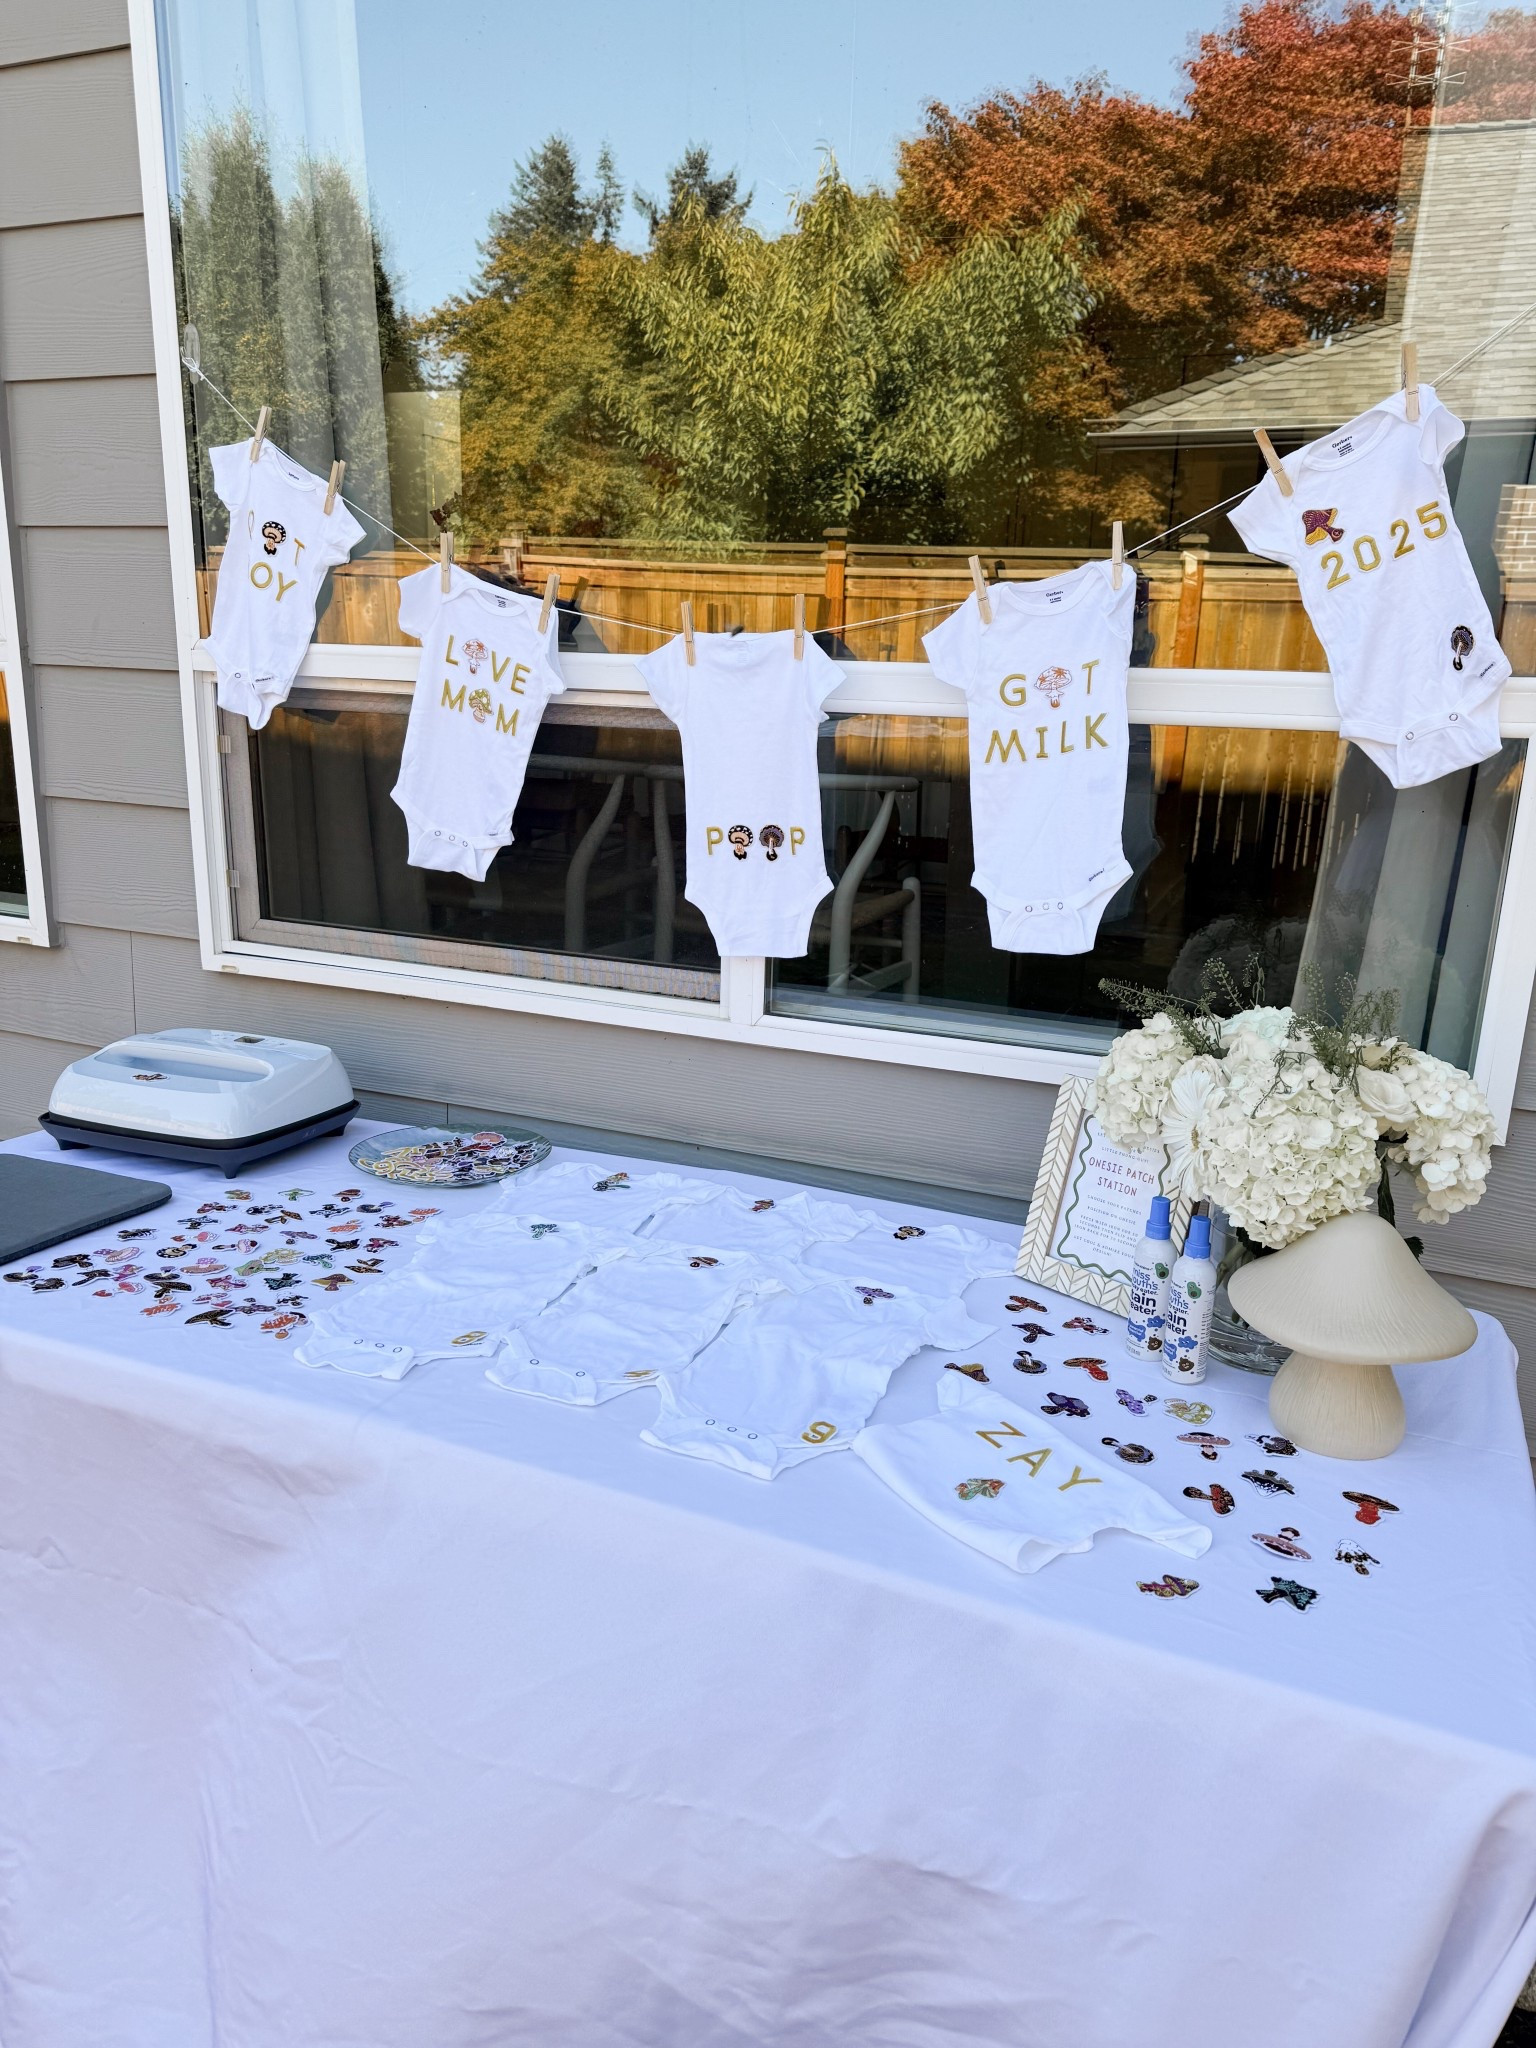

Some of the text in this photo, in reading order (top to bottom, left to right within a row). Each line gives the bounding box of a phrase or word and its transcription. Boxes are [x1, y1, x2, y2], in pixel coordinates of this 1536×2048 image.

[1320, 501, 1449, 590] 2025
[250, 561, 298, 601] OY
[984, 713, 1109, 763] MILK
[1089, 1157, 1155, 1185] ONESIE PATCH
[1097, 1176, 1137, 1196] STATION
[1131, 1288, 1157, 1307] tain
[1168, 1311, 1187, 1327] ain
[975, 1421, 1103, 1491] ZAY
